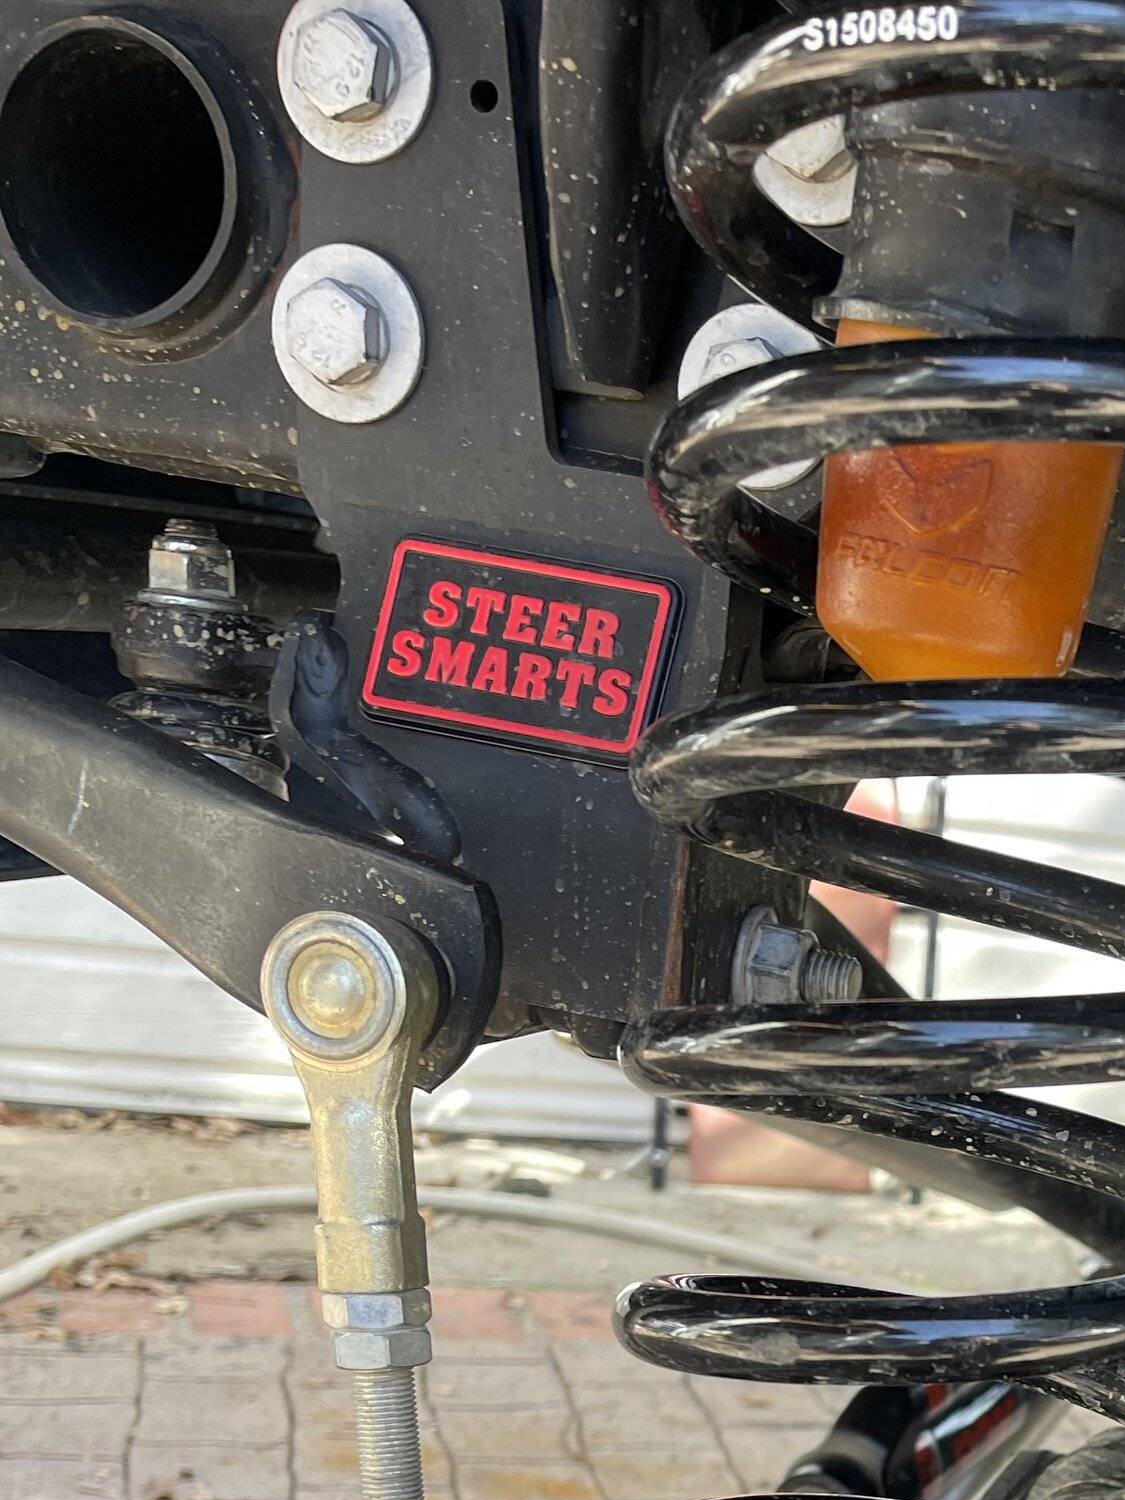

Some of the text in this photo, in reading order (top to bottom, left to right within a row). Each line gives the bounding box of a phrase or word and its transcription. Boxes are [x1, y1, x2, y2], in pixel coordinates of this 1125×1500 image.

[802, 5, 959, 51] S1508450
[422, 580, 621, 660] STEER
[386, 629, 633, 717] SMARTS
